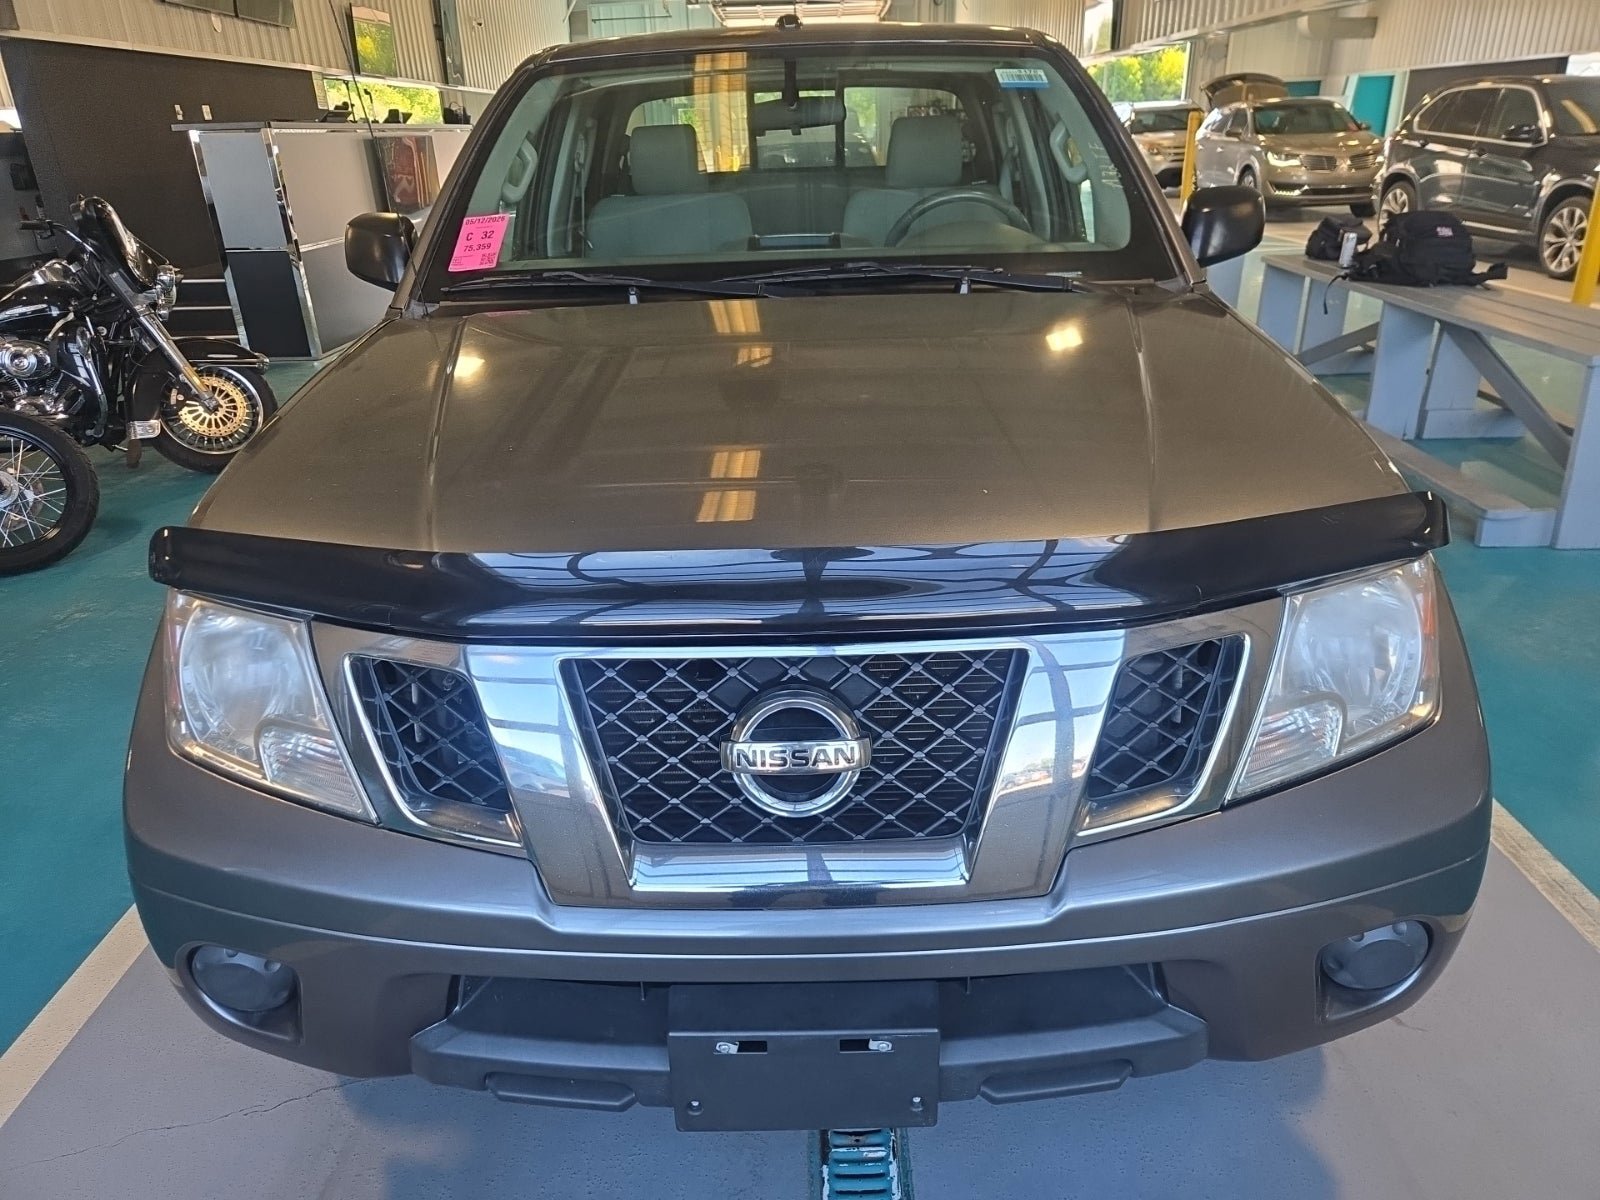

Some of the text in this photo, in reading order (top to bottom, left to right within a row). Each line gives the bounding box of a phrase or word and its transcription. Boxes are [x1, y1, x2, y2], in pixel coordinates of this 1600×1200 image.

[466, 230, 495, 241] C 32
[735, 746, 856, 768] NISSAN
